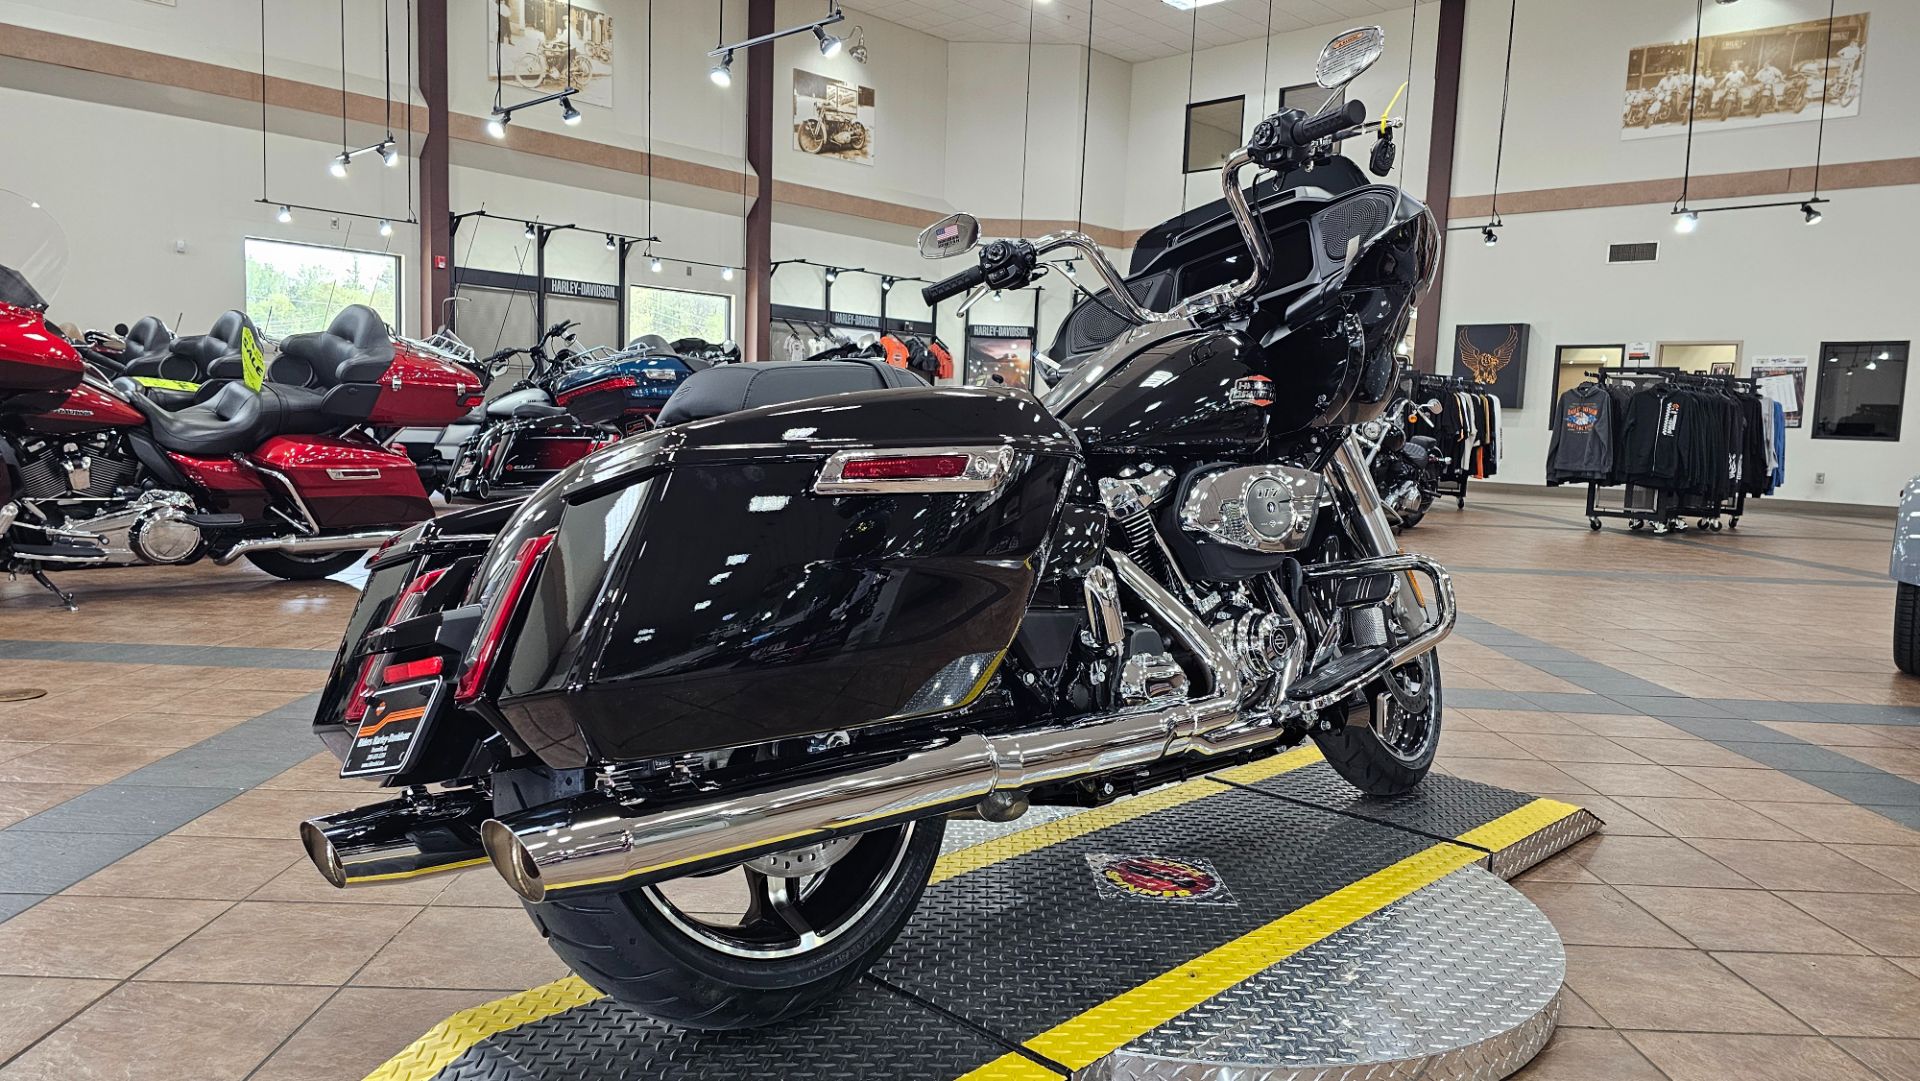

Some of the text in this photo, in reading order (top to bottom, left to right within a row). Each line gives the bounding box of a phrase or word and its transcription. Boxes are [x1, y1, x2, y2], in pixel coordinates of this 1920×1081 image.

[551, 279, 615, 299] HARLEY-DAVIDSON
[835, 312, 879, 328] HARLEY-DAVIDSON
[973, 325, 1029, 337] HARLEY-DAVIDSON
[243, 337, 264, 377] SALE
[1257, 488, 1278, 498] 117
